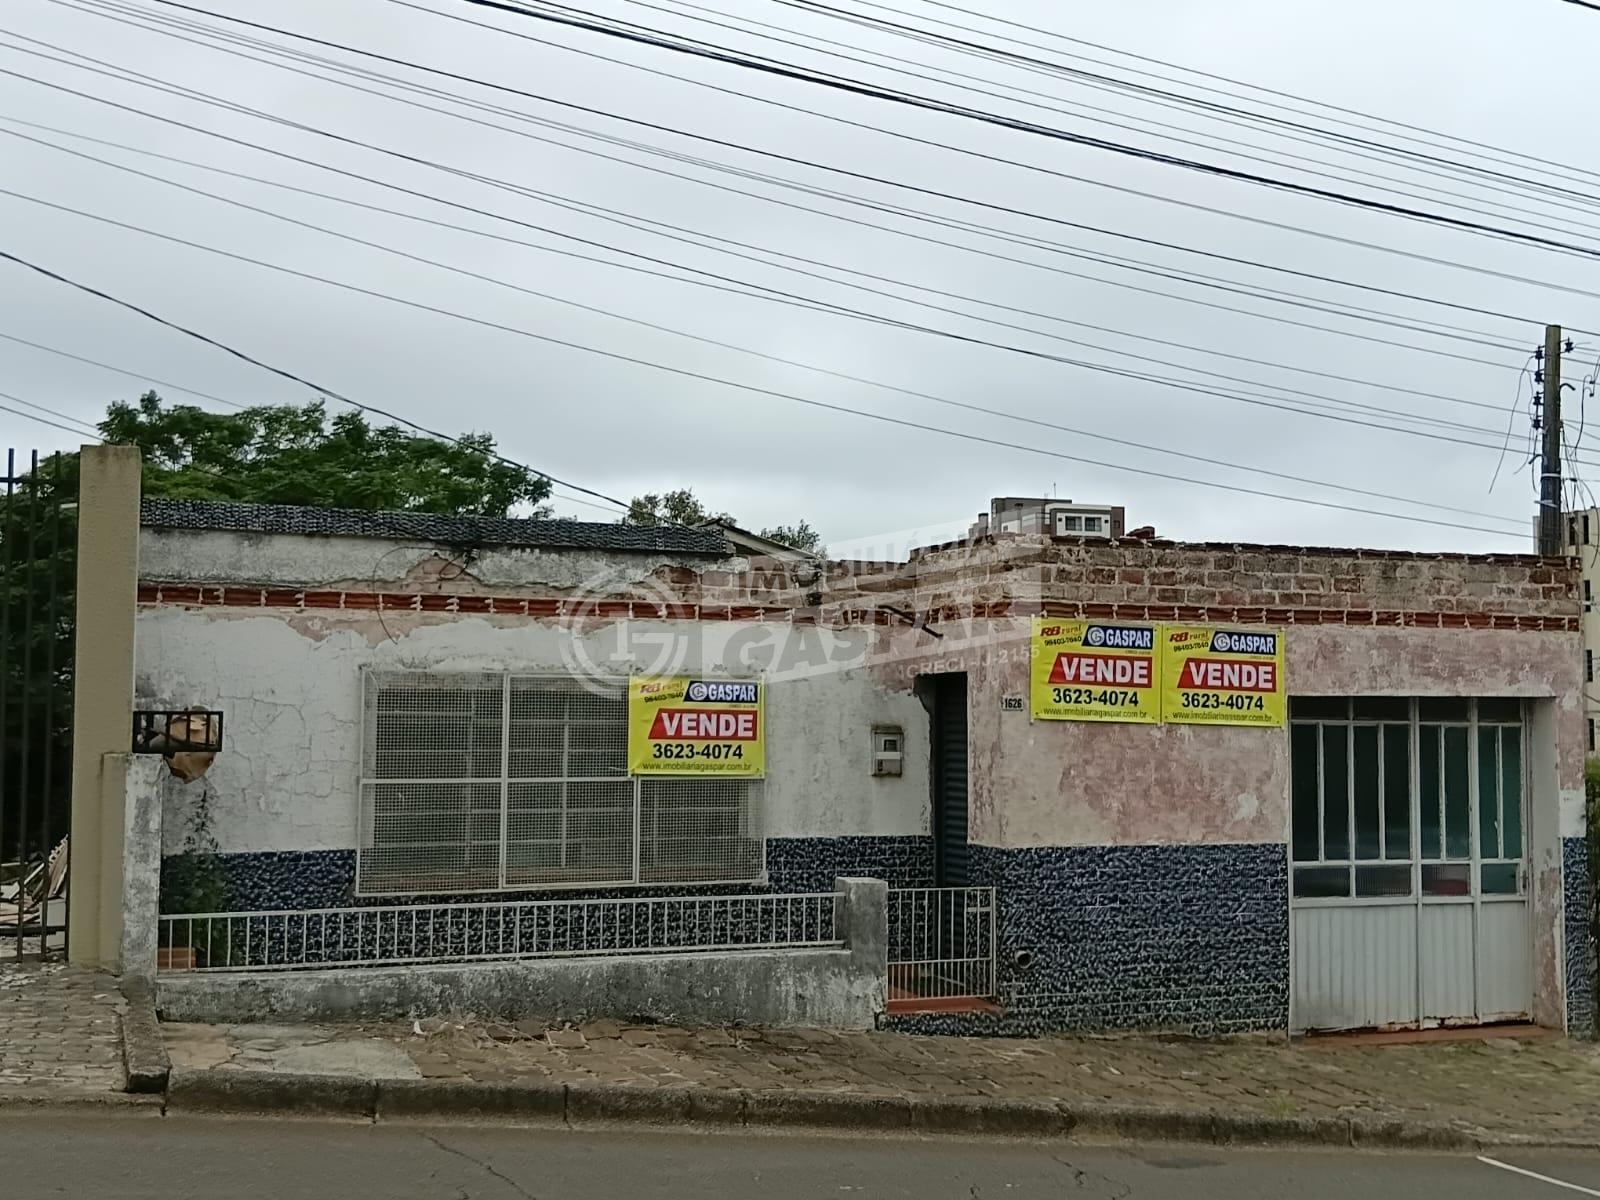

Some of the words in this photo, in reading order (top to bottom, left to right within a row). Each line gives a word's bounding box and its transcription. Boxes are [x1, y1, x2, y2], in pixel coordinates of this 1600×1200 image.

[1105, 629, 1151, 648] GASPAR
[1231, 635, 1274, 653] GASPAR
[1060, 656, 1148, 684] VENDE
[1189, 662, 1273, 689] VENDE
[708, 683, 756, 701] GASPAR
[1053, 688, 1139, 706] 3623-4074
[1181, 692, 1264, 710] 3623-4074
[1004, 697, 1022, 709] 1626
[1043, 706, 1147, 719] www.imobiliariagaspar.com.br
[661, 712, 753, 736] VENDE
[652, 743, 743, 759] 3623-4074
[642, 761, 752, 773] www.imobiliariagaspar.com.br
